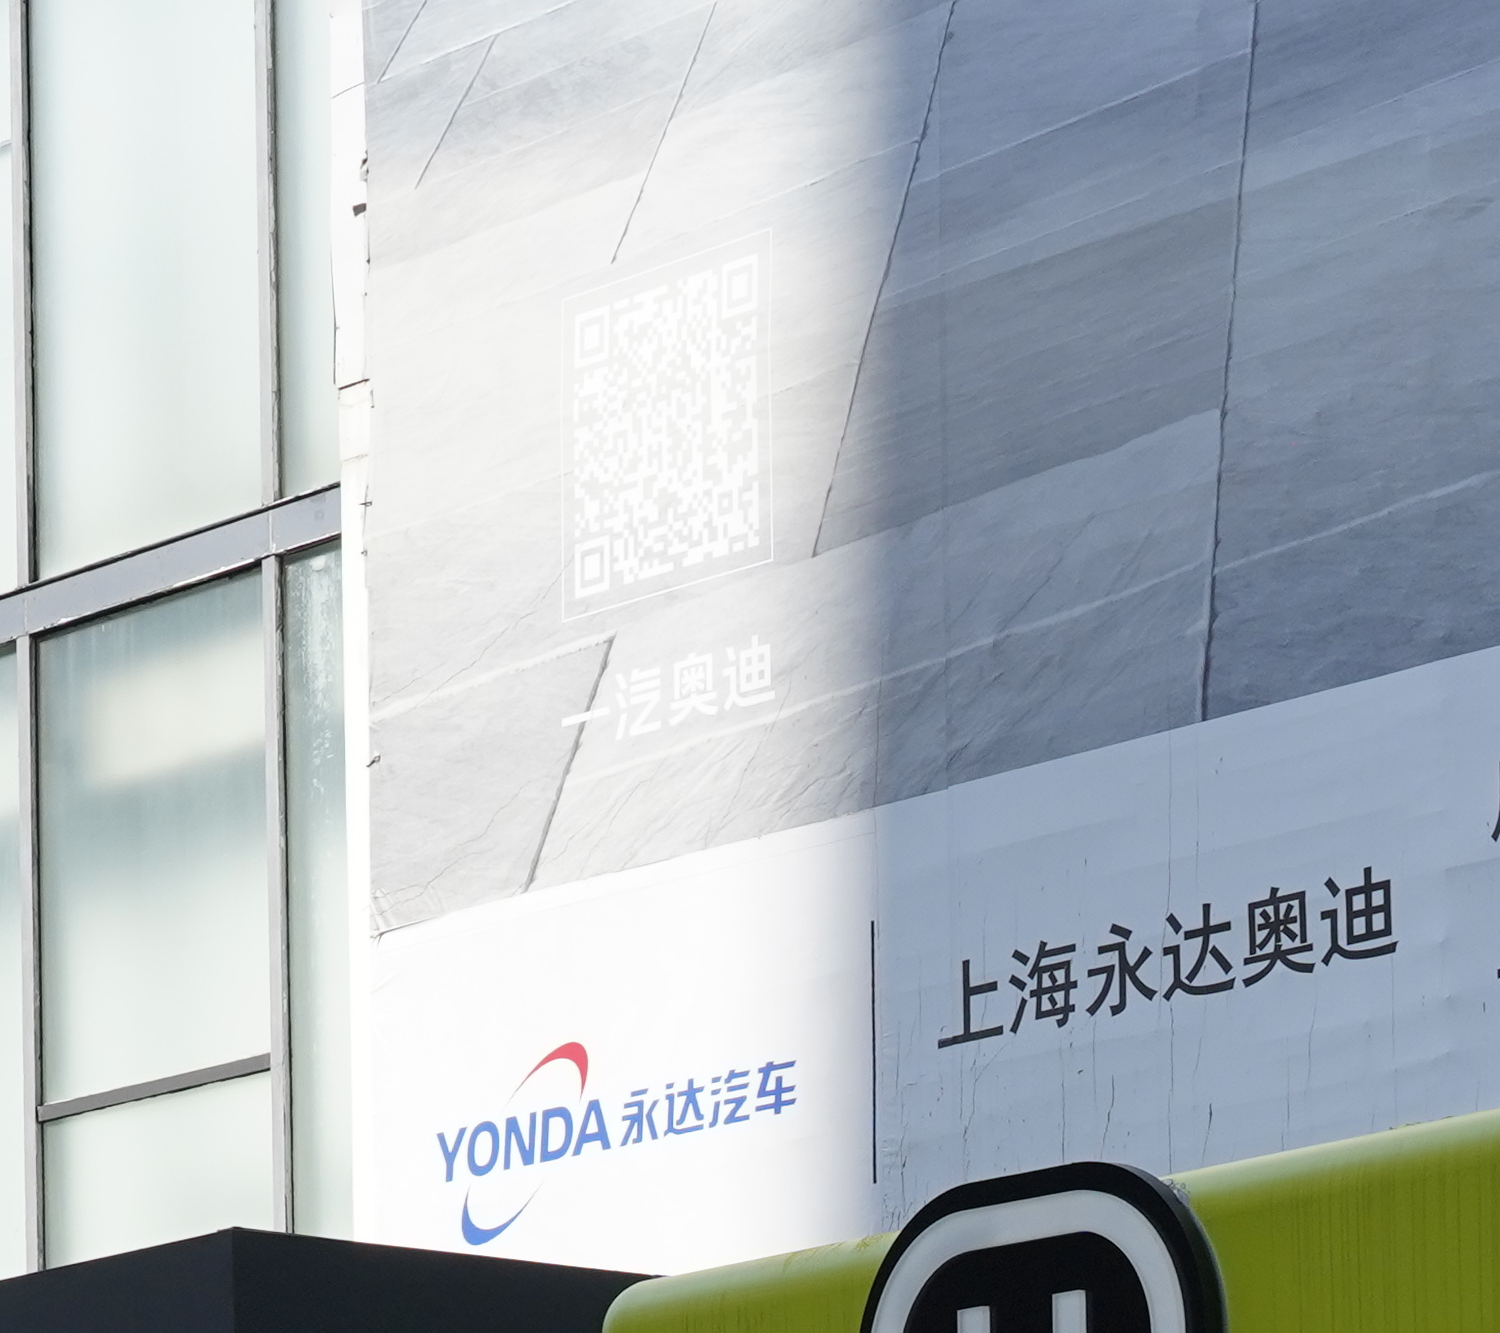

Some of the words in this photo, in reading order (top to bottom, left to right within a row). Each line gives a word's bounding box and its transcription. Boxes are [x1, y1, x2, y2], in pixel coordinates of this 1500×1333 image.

[562, 634, 776, 741] 一汽奥迪
[937, 866, 1397, 1050] 上海永达奥迪
[436, 1097, 610, 1182] YONDA
[620, 1058, 798, 1147] 永达汽车
